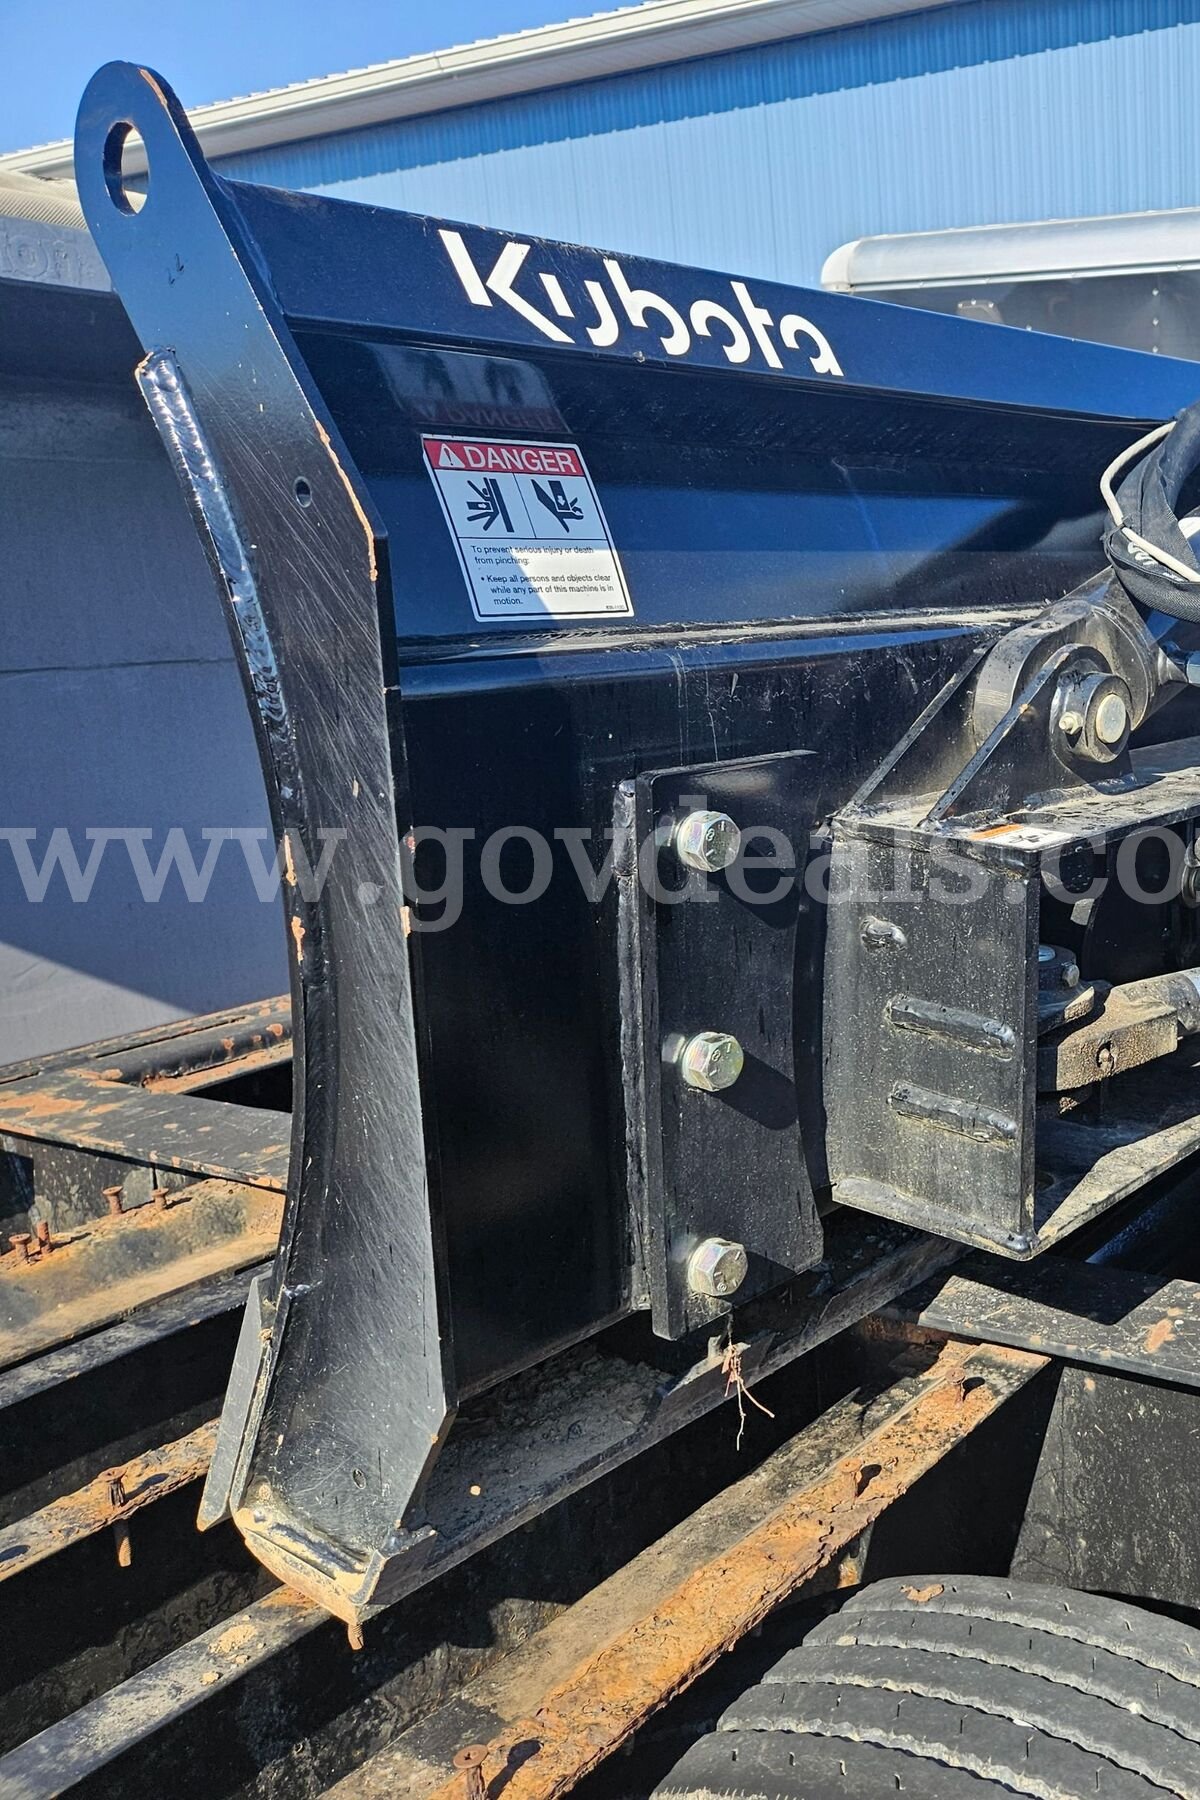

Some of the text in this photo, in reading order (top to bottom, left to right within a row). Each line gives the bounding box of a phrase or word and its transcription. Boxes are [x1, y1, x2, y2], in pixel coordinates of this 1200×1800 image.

[438, 229, 844, 377] Kubota
[463, 446, 577, 473] DANGER
[471, 545, 482, 554] To
[484, 546, 512, 555] prevent
[515, 546, 542, 554] serious
[543, 545, 563, 556] injury
[574, 546, 593, 554] death
[475, 557, 493, 565] from
[487, 575, 508, 584] Keep
[520, 576, 550, 584] persons
[552, 575, 565, 583] and
[567, 575, 593, 584] objects
[491, 586, 512, 594] while
[513, 587, 526, 595] any
[528, 586, 543, 595] part
[600, 585, 606, 593] is
[493, 597, 524, 606] motion.
